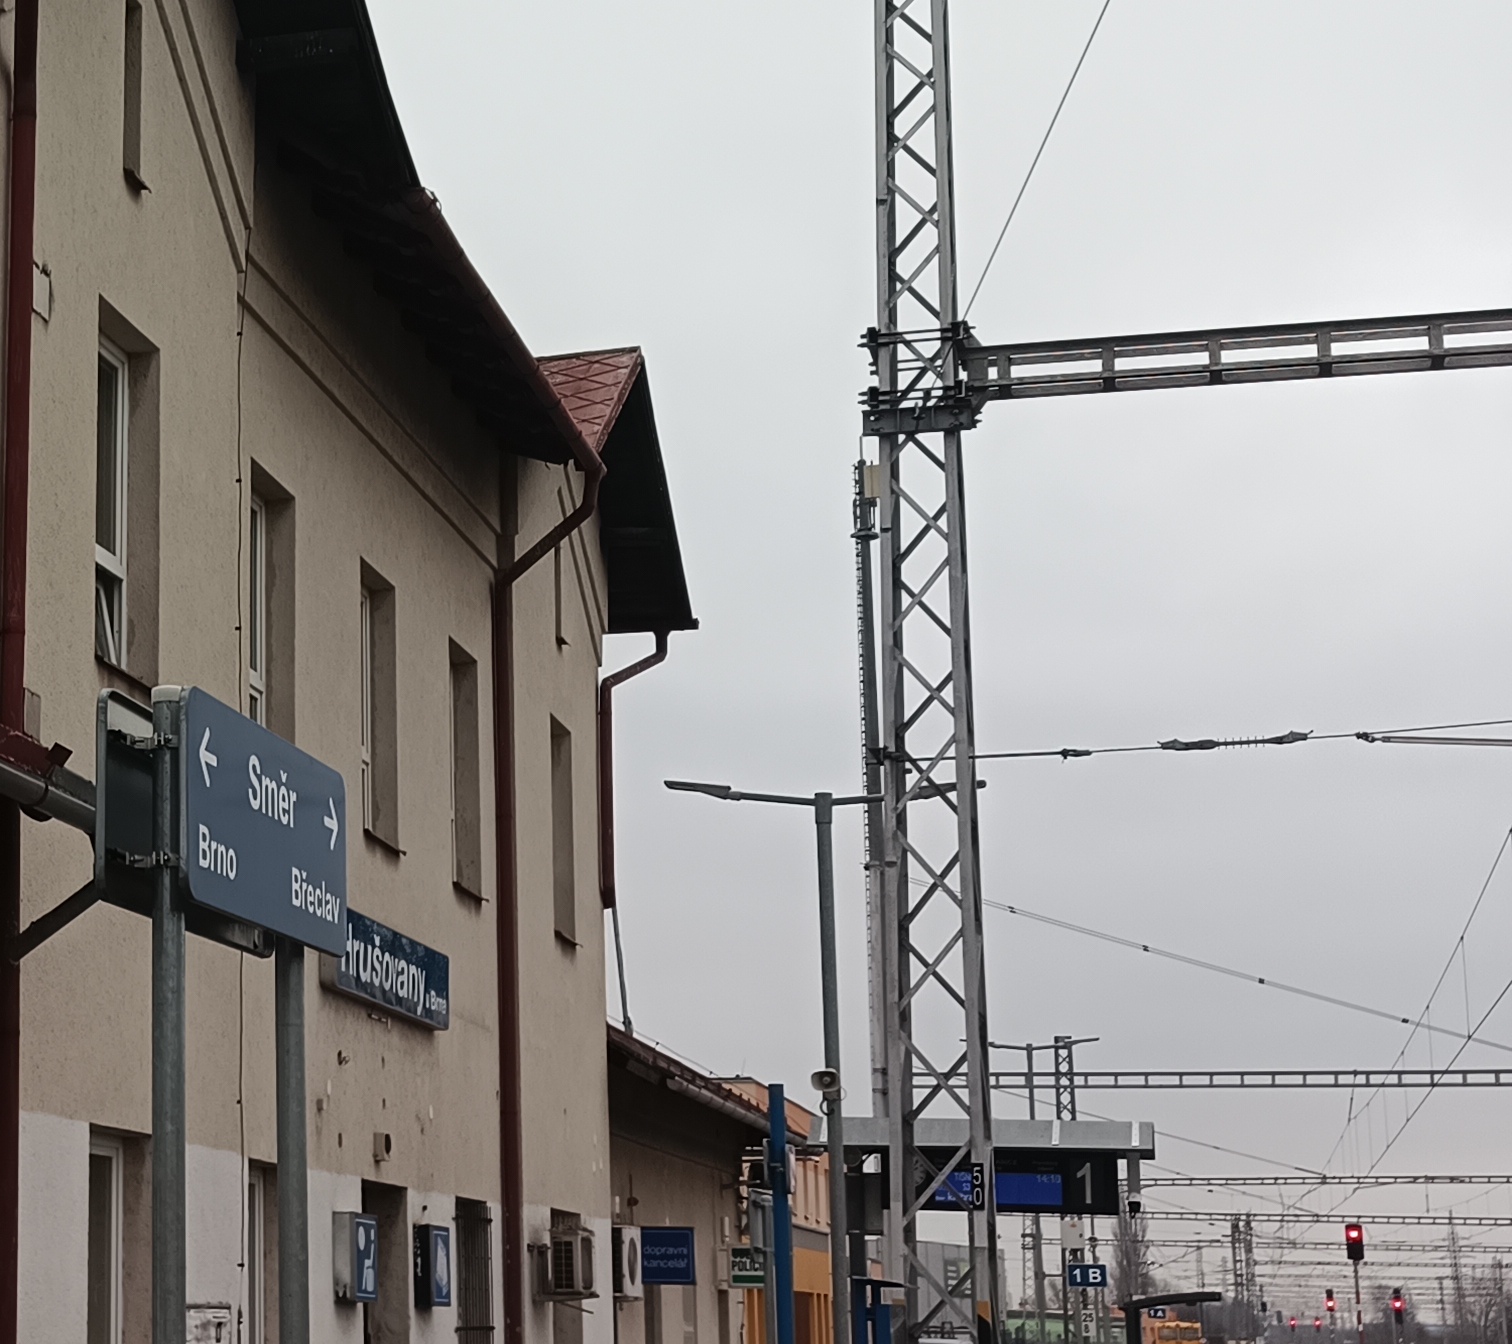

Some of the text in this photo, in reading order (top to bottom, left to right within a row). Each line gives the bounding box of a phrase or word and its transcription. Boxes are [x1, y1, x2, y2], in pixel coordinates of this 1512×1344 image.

[248, 754, 297, 828] Směr
[198, 823, 237, 881] Brno
[291, 866, 341, 925] Břeclav
[1076, 1162, 1092, 1205] 1
[643, 1243, 688, 1256] dopravní
[643, 1257, 688, 1269] kancelář
[1082, 1313, 1094, 1323] 25
